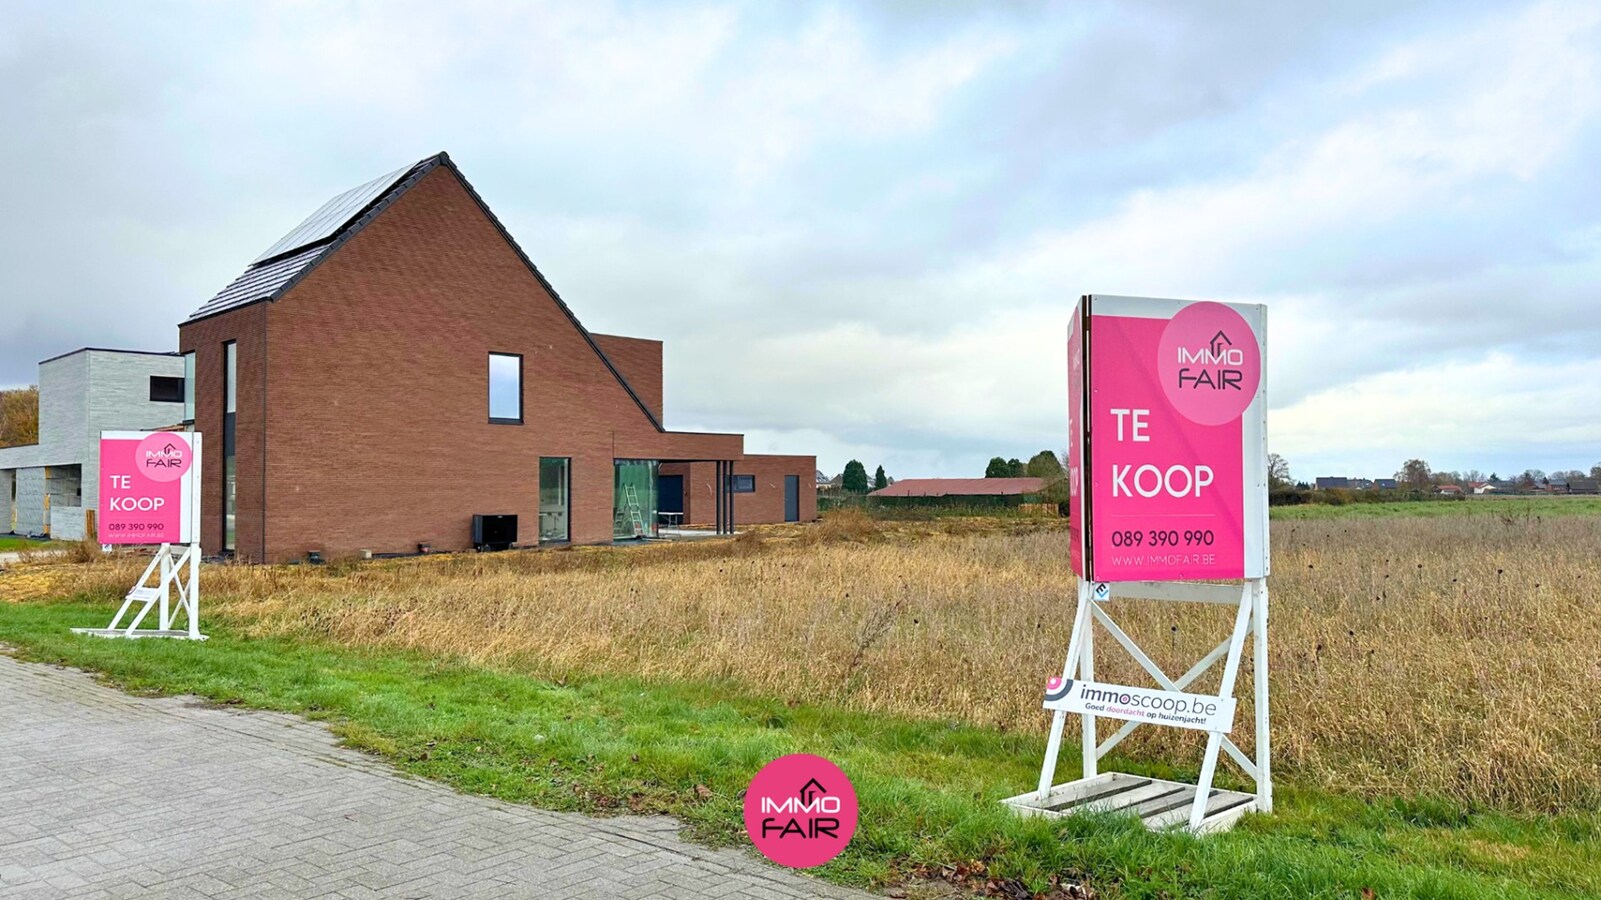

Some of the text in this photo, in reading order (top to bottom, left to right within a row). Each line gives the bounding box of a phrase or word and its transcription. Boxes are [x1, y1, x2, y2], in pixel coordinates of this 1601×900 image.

[1177, 346, 1243, 366] IMMO
[1178, 368, 1242, 391] FAIR
[1110, 408, 1150, 442] TE
[145, 450, 182, 458] IMMO
[146, 459, 182, 468] FAIR
[110, 475, 131, 489] TE
[1112, 464, 1214, 498] KOOP
[110, 497, 165, 511] KOOP
[108, 523, 164, 531] 089 390 990
[1111, 529, 1214, 547] 089 390 990
[1111, 553, 1216, 566] WWW.IMMOFAIR.BE
[1080, 684, 1217, 716] immoscoop.be
[1085, 702, 1207, 725] Goed doordacht op huizenjacht!
